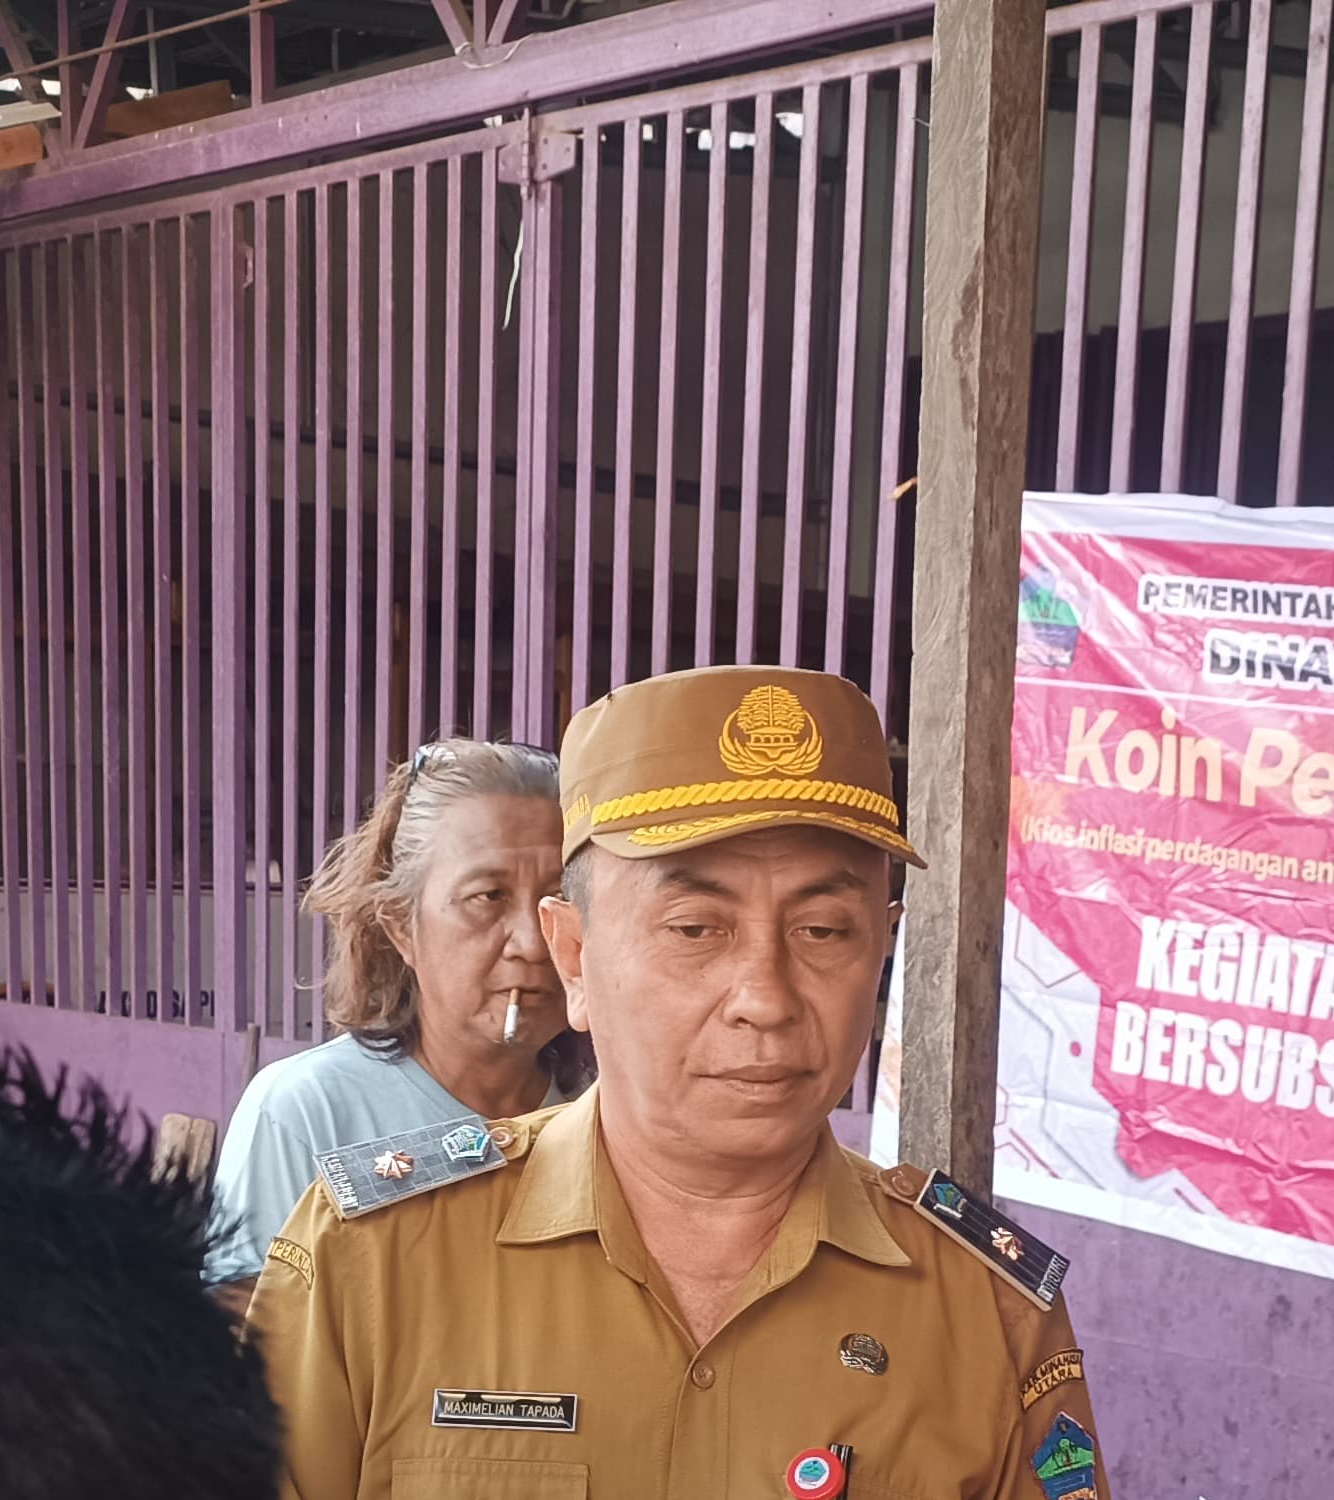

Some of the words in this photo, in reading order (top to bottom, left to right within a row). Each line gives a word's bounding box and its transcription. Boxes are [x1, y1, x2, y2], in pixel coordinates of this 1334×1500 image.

[1063, 707, 1223, 802] Koin
[1079, 820, 1144, 857] inflasi
[1144, 836, 1299, 881] perdagangan
[443, 1400, 515, 1416] MAXIMELIAN
[520, 1403, 565, 1418] TAPADA
